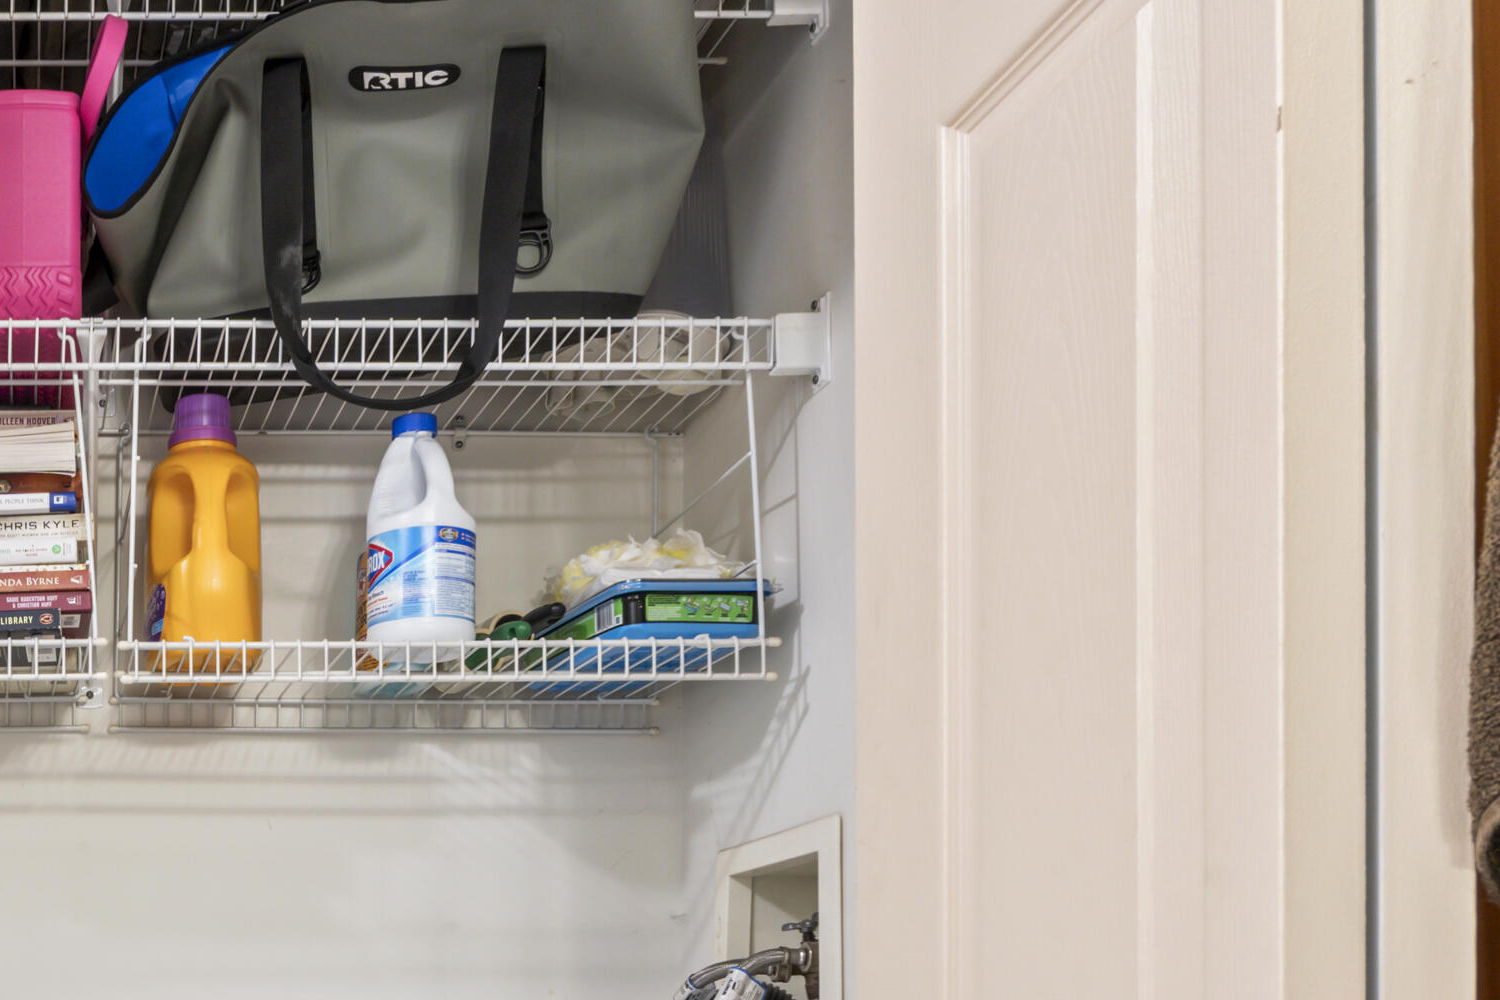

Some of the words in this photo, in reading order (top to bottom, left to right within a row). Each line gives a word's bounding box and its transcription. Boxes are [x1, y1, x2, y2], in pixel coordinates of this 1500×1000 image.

[362, 70, 449, 90] RTIC
[26, 416, 56, 426] HOOVER
[43, 519, 79, 530] KYLE
[26, 576, 60, 586] BYRNE
[0, 615, 33, 626] LIBRARY
